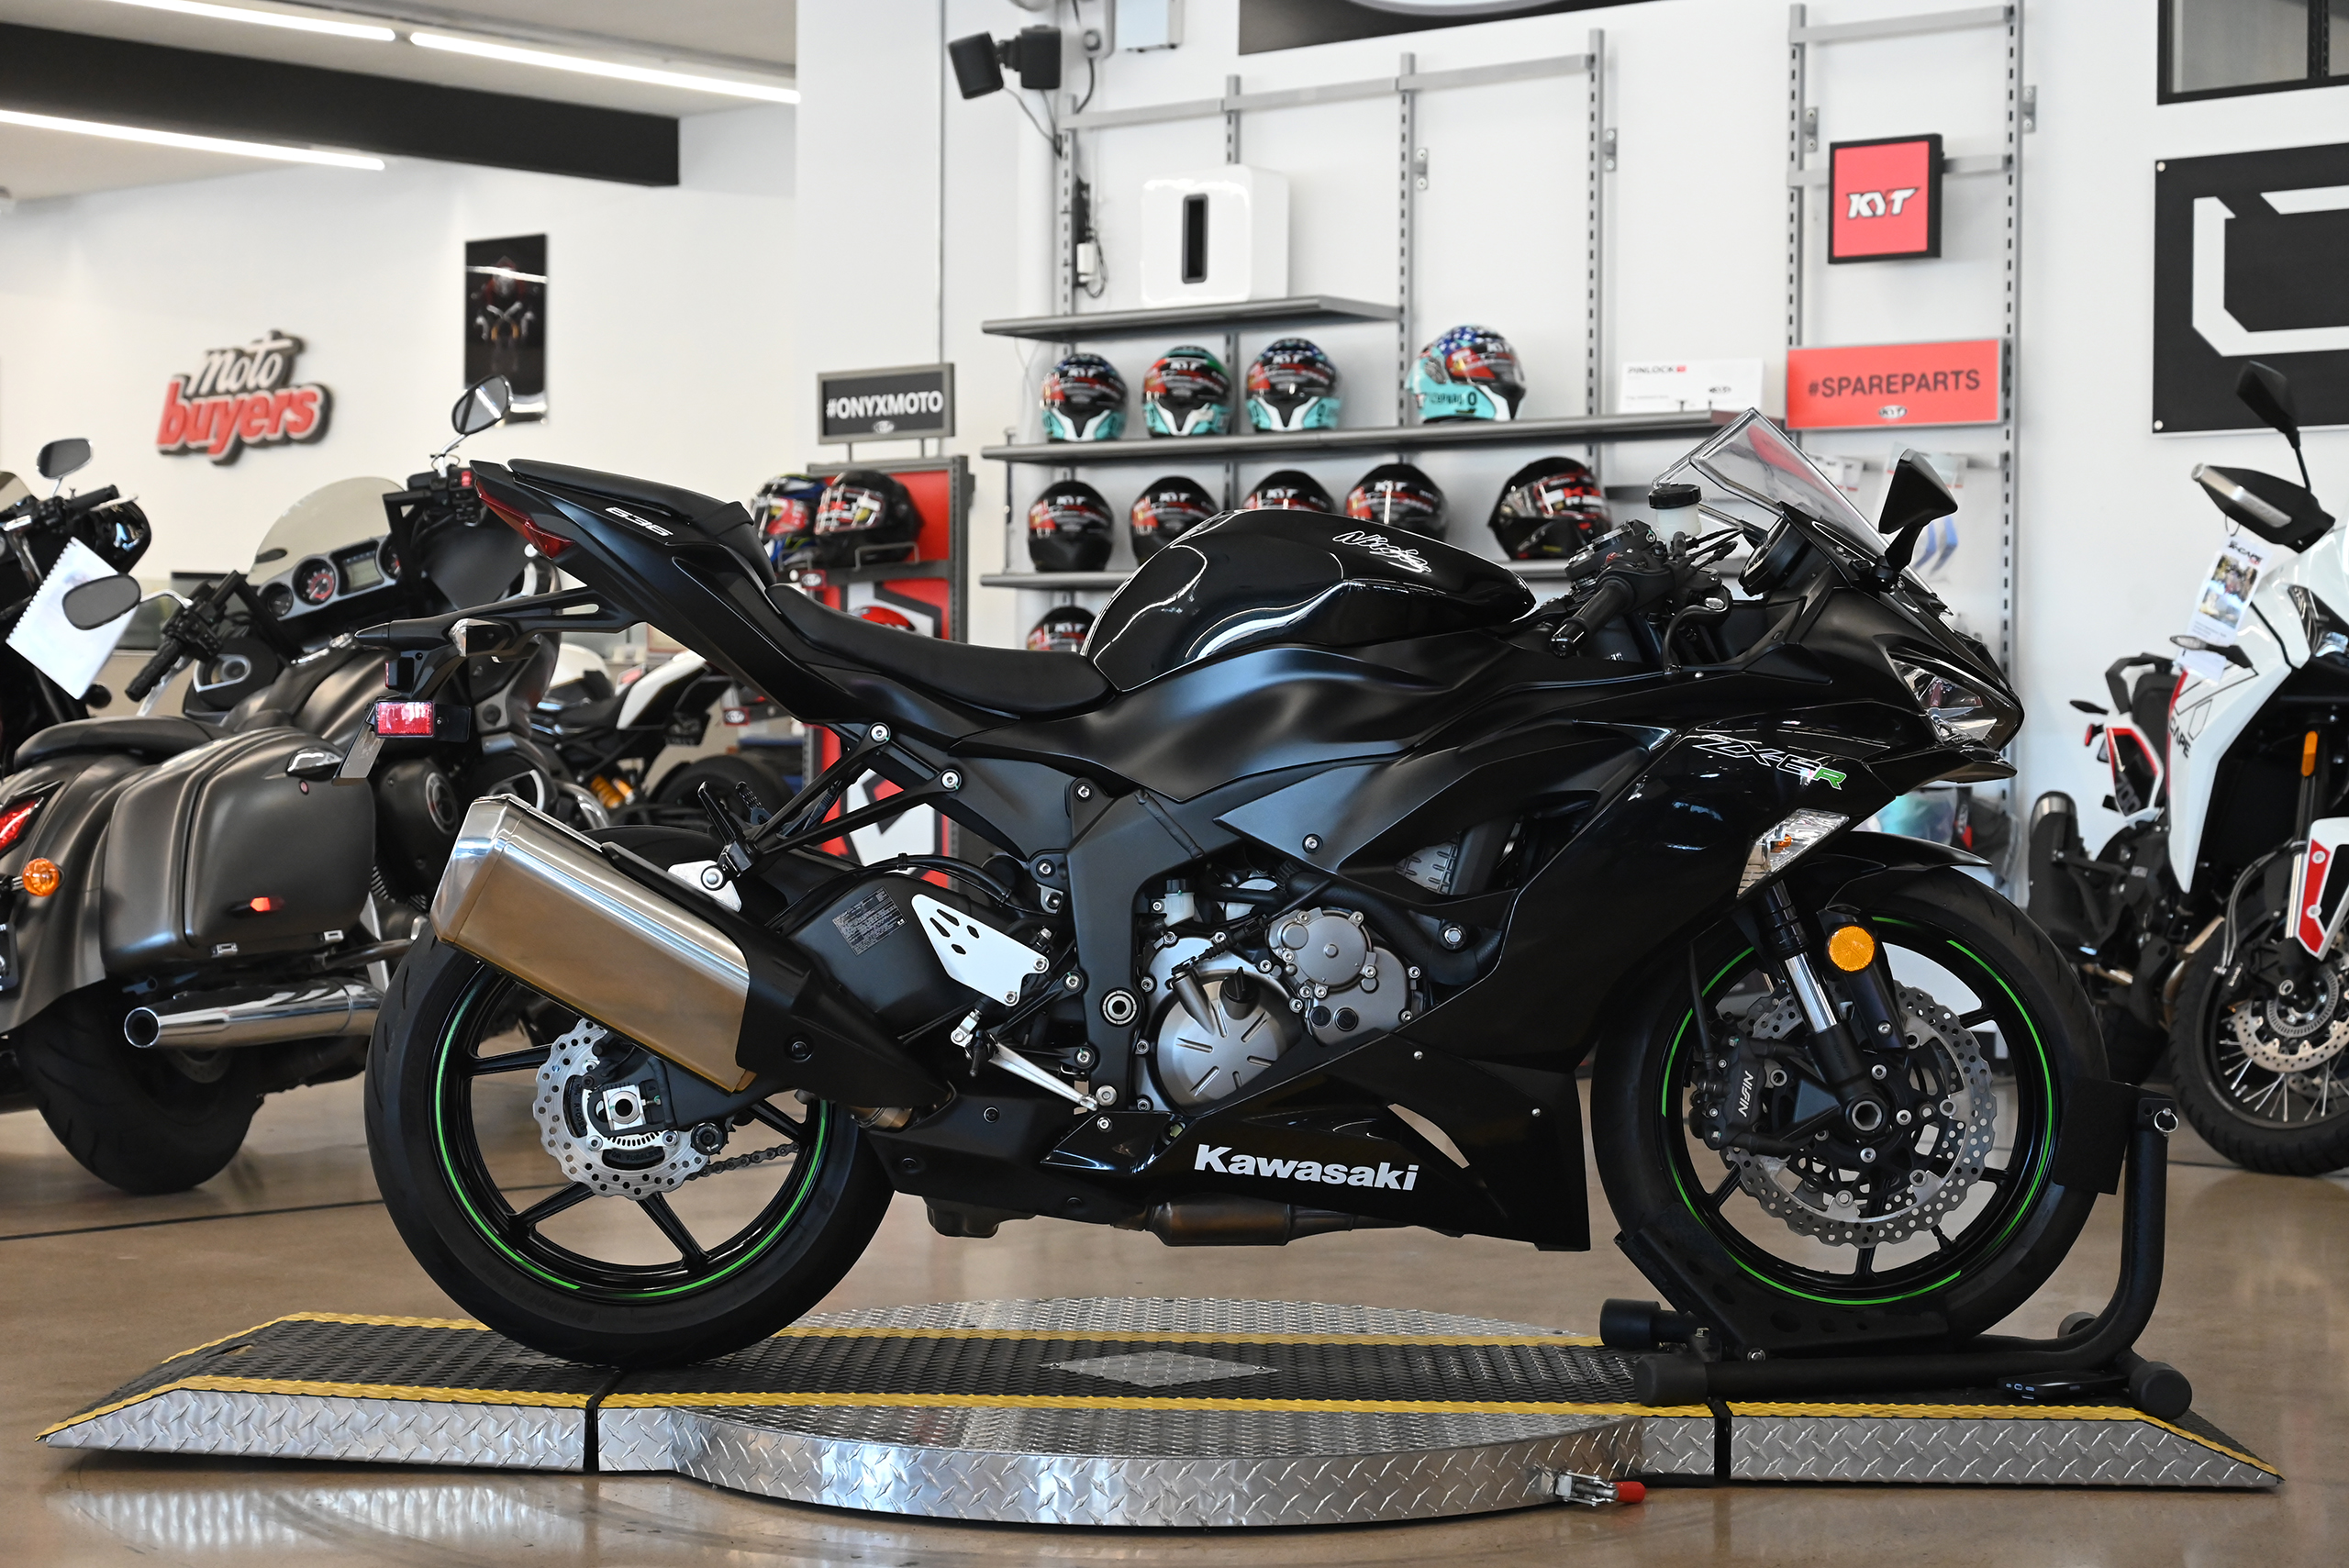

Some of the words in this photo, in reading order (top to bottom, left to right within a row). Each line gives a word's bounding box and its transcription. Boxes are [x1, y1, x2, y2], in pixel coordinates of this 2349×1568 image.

[1847, 187, 1920, 218] KYT
[1808, 369, 1981, 398] #SPAREPARTS
[156, 379, 320, 458] buyers
[826, 390, 944, 419] #ONYXMOTO
[606, 507, 674, 537] 636
[1194, 1144, 1419, 1191] Kawasaki
